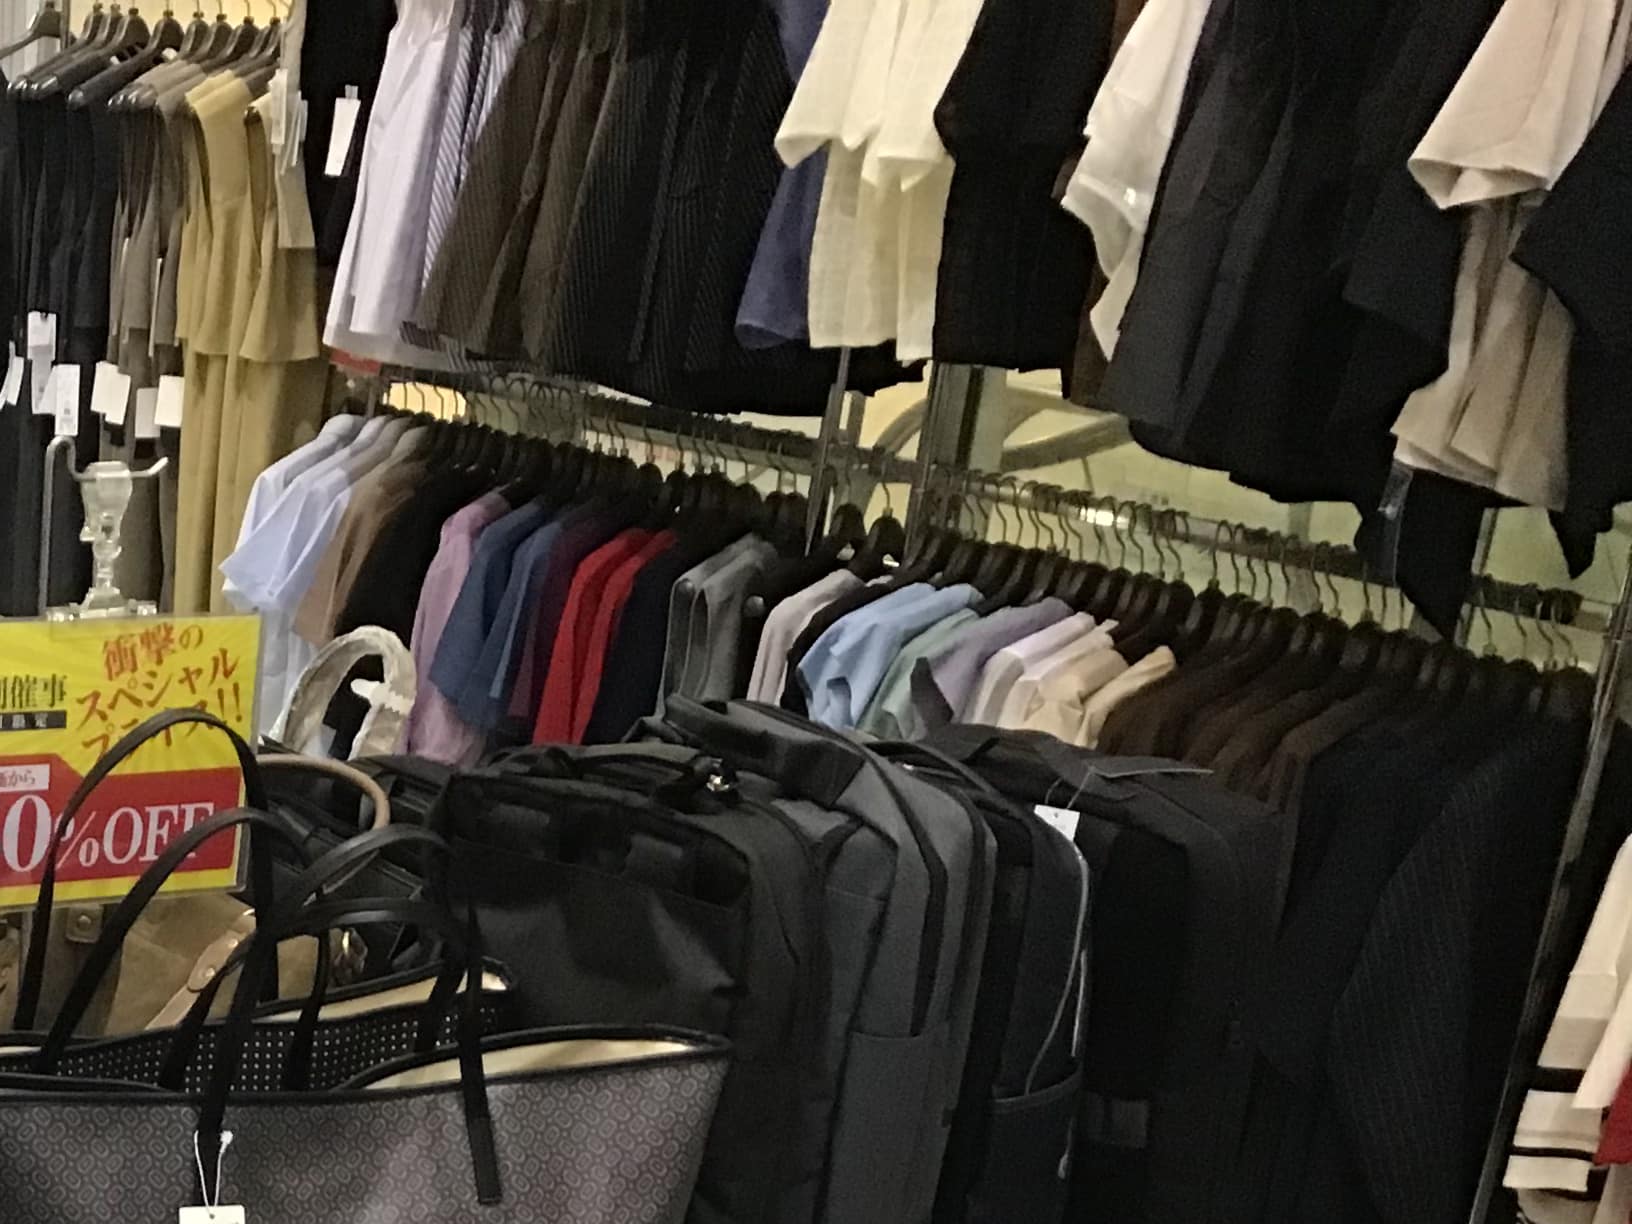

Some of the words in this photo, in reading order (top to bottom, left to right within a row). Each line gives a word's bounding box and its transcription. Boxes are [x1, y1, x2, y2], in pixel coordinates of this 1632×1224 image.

[102, 622, 205, 682] 衝撃の
[75, 647, 241, 732] スペシャル
